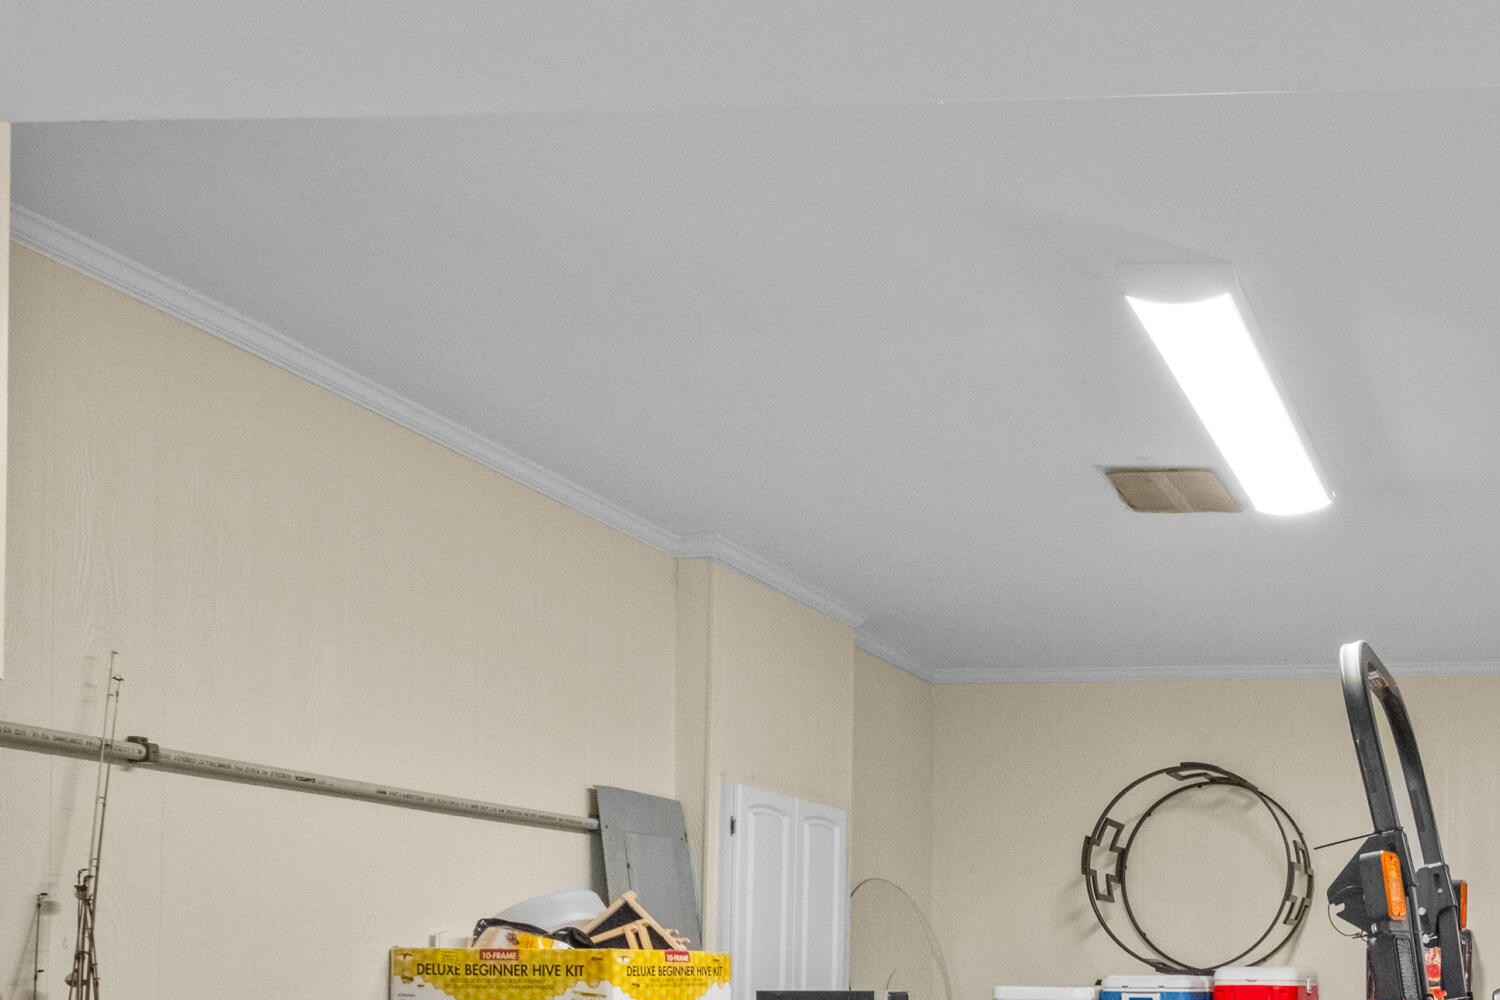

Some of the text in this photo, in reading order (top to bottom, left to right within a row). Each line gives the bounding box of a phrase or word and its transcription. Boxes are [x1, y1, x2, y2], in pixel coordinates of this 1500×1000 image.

[481, 952, 517, 960] 10-FRAME
[416, 963, 584, 977] DELUXE BEGINNER HIVE KIT
[626, 966, 723, 977] DELUXE BEGINNER HIVE KIT
